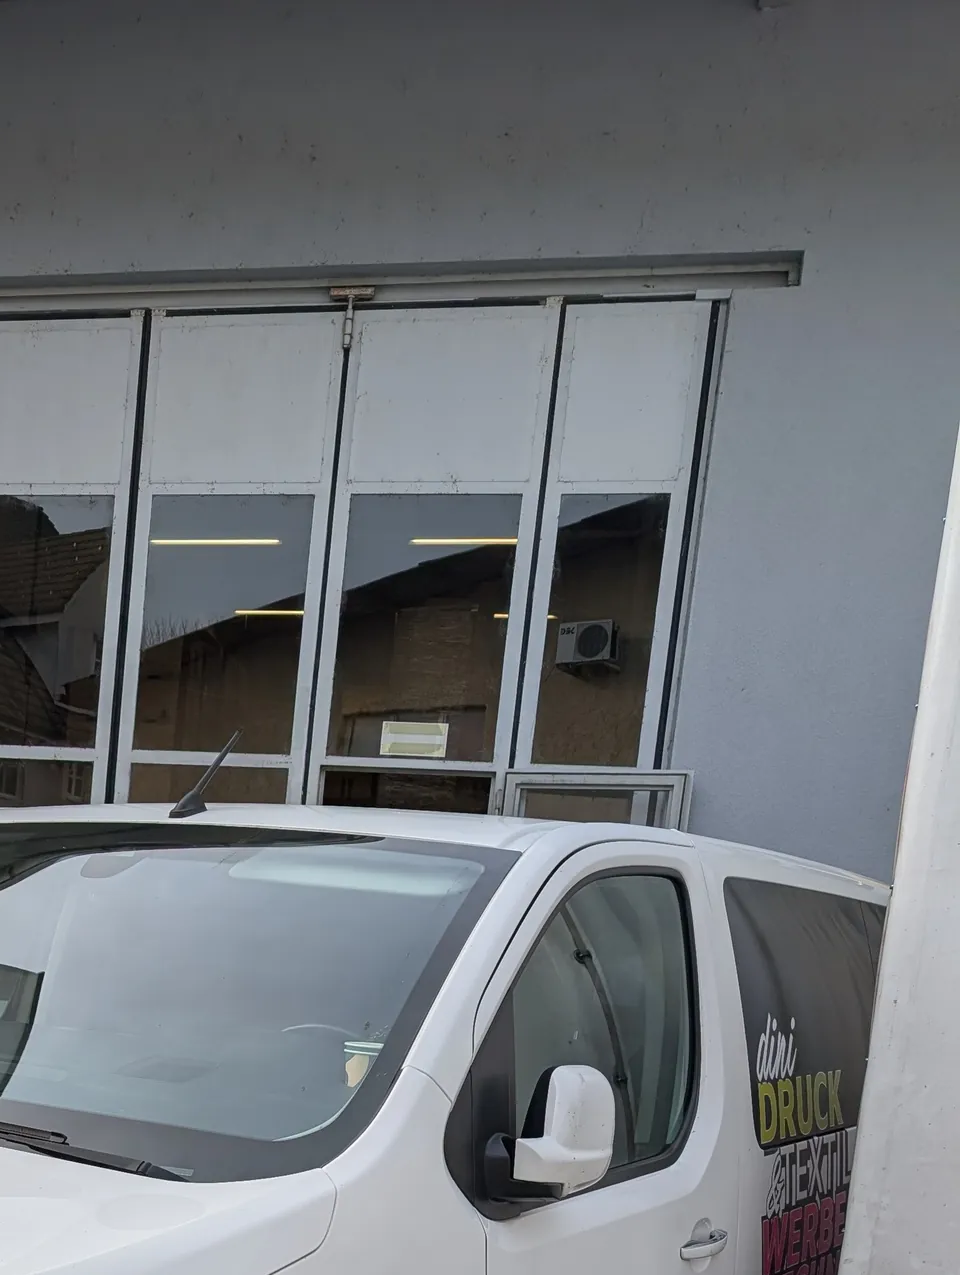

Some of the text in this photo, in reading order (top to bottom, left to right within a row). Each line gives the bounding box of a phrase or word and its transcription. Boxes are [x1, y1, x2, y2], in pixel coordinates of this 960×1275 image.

[757, 1013, 797, 1081] dini
[757, 1069, 844, 1145] DRUCK
[766, 1131, 853, 1219] & TEXTIL
